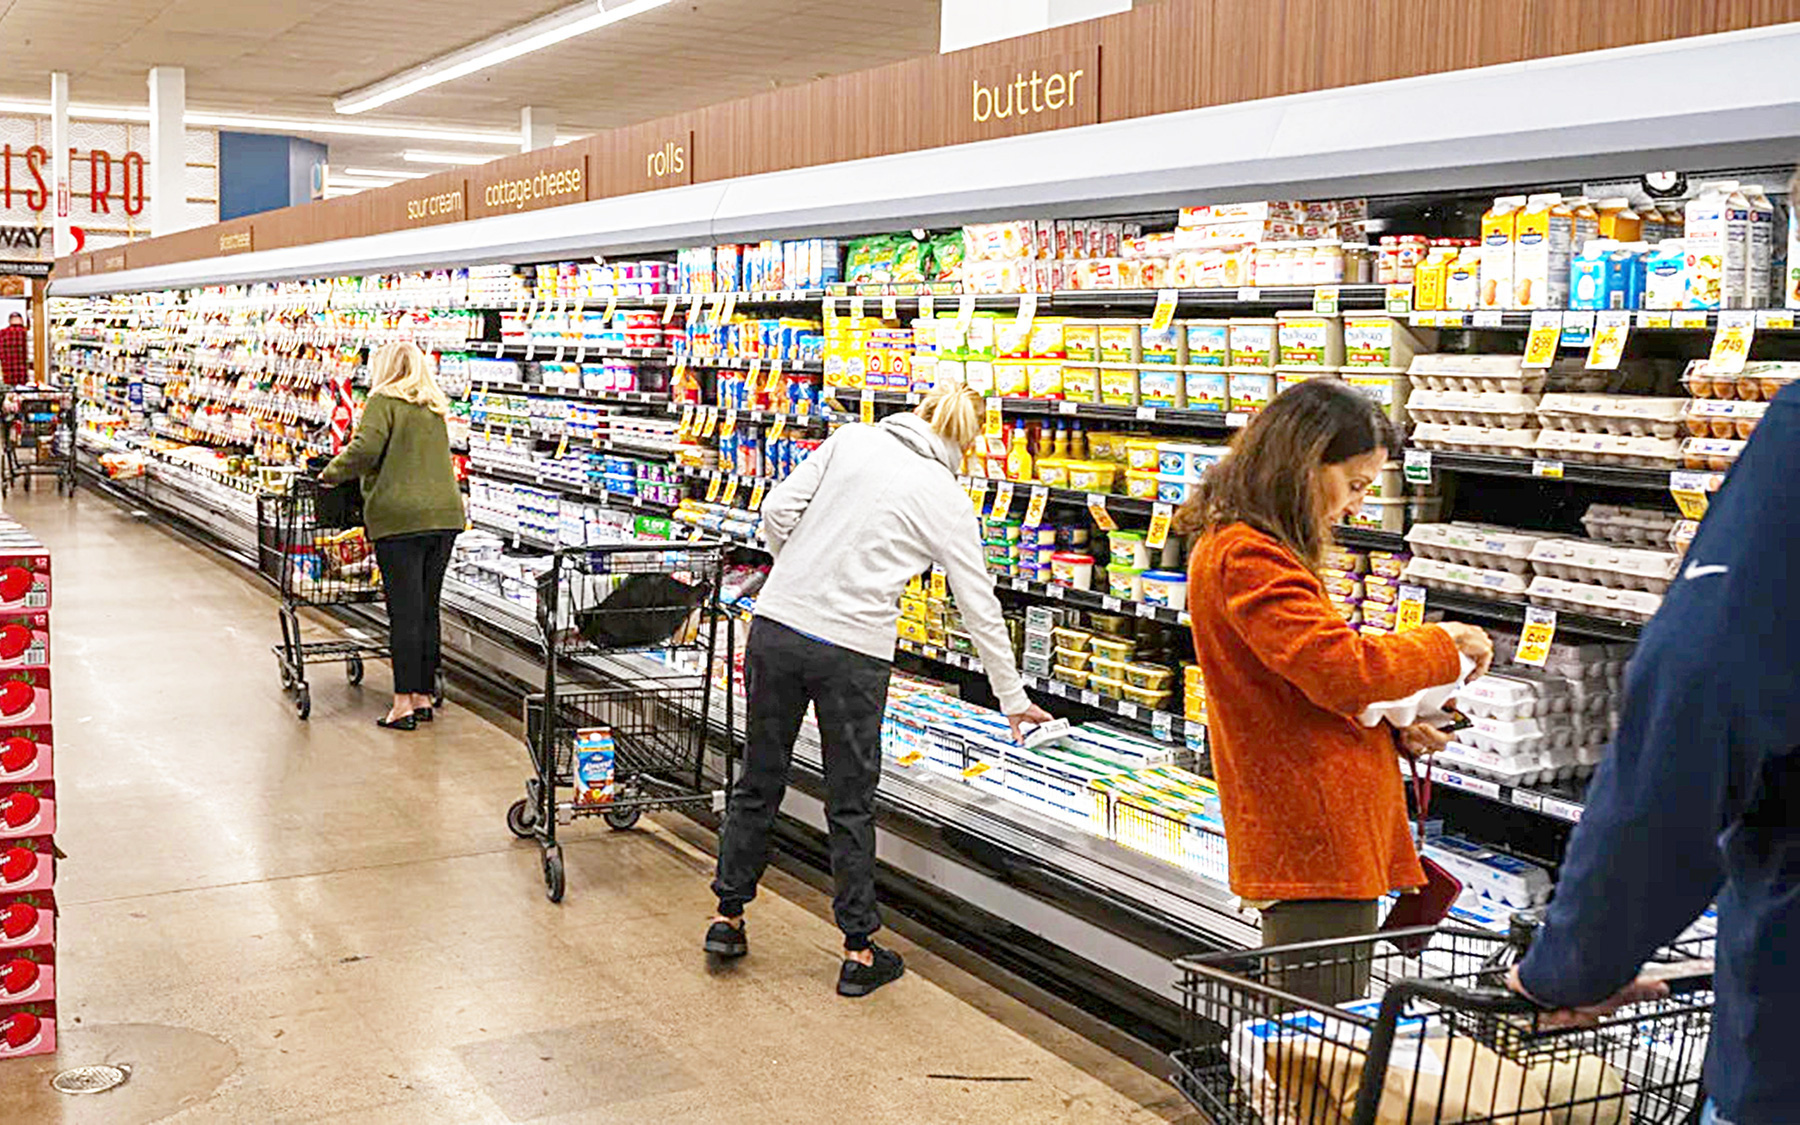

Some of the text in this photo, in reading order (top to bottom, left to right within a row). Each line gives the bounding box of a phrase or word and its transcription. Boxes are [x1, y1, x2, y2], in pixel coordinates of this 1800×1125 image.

[973, 69, 1084, 122] butter
[647, 142, 684, 178] rolls
[485, 168, 581, 209] cottage cheese
[407, 191, 462, 220] sour cream
[35, 557, 48, 567] 12
[34, 614, 46, 624] 12
